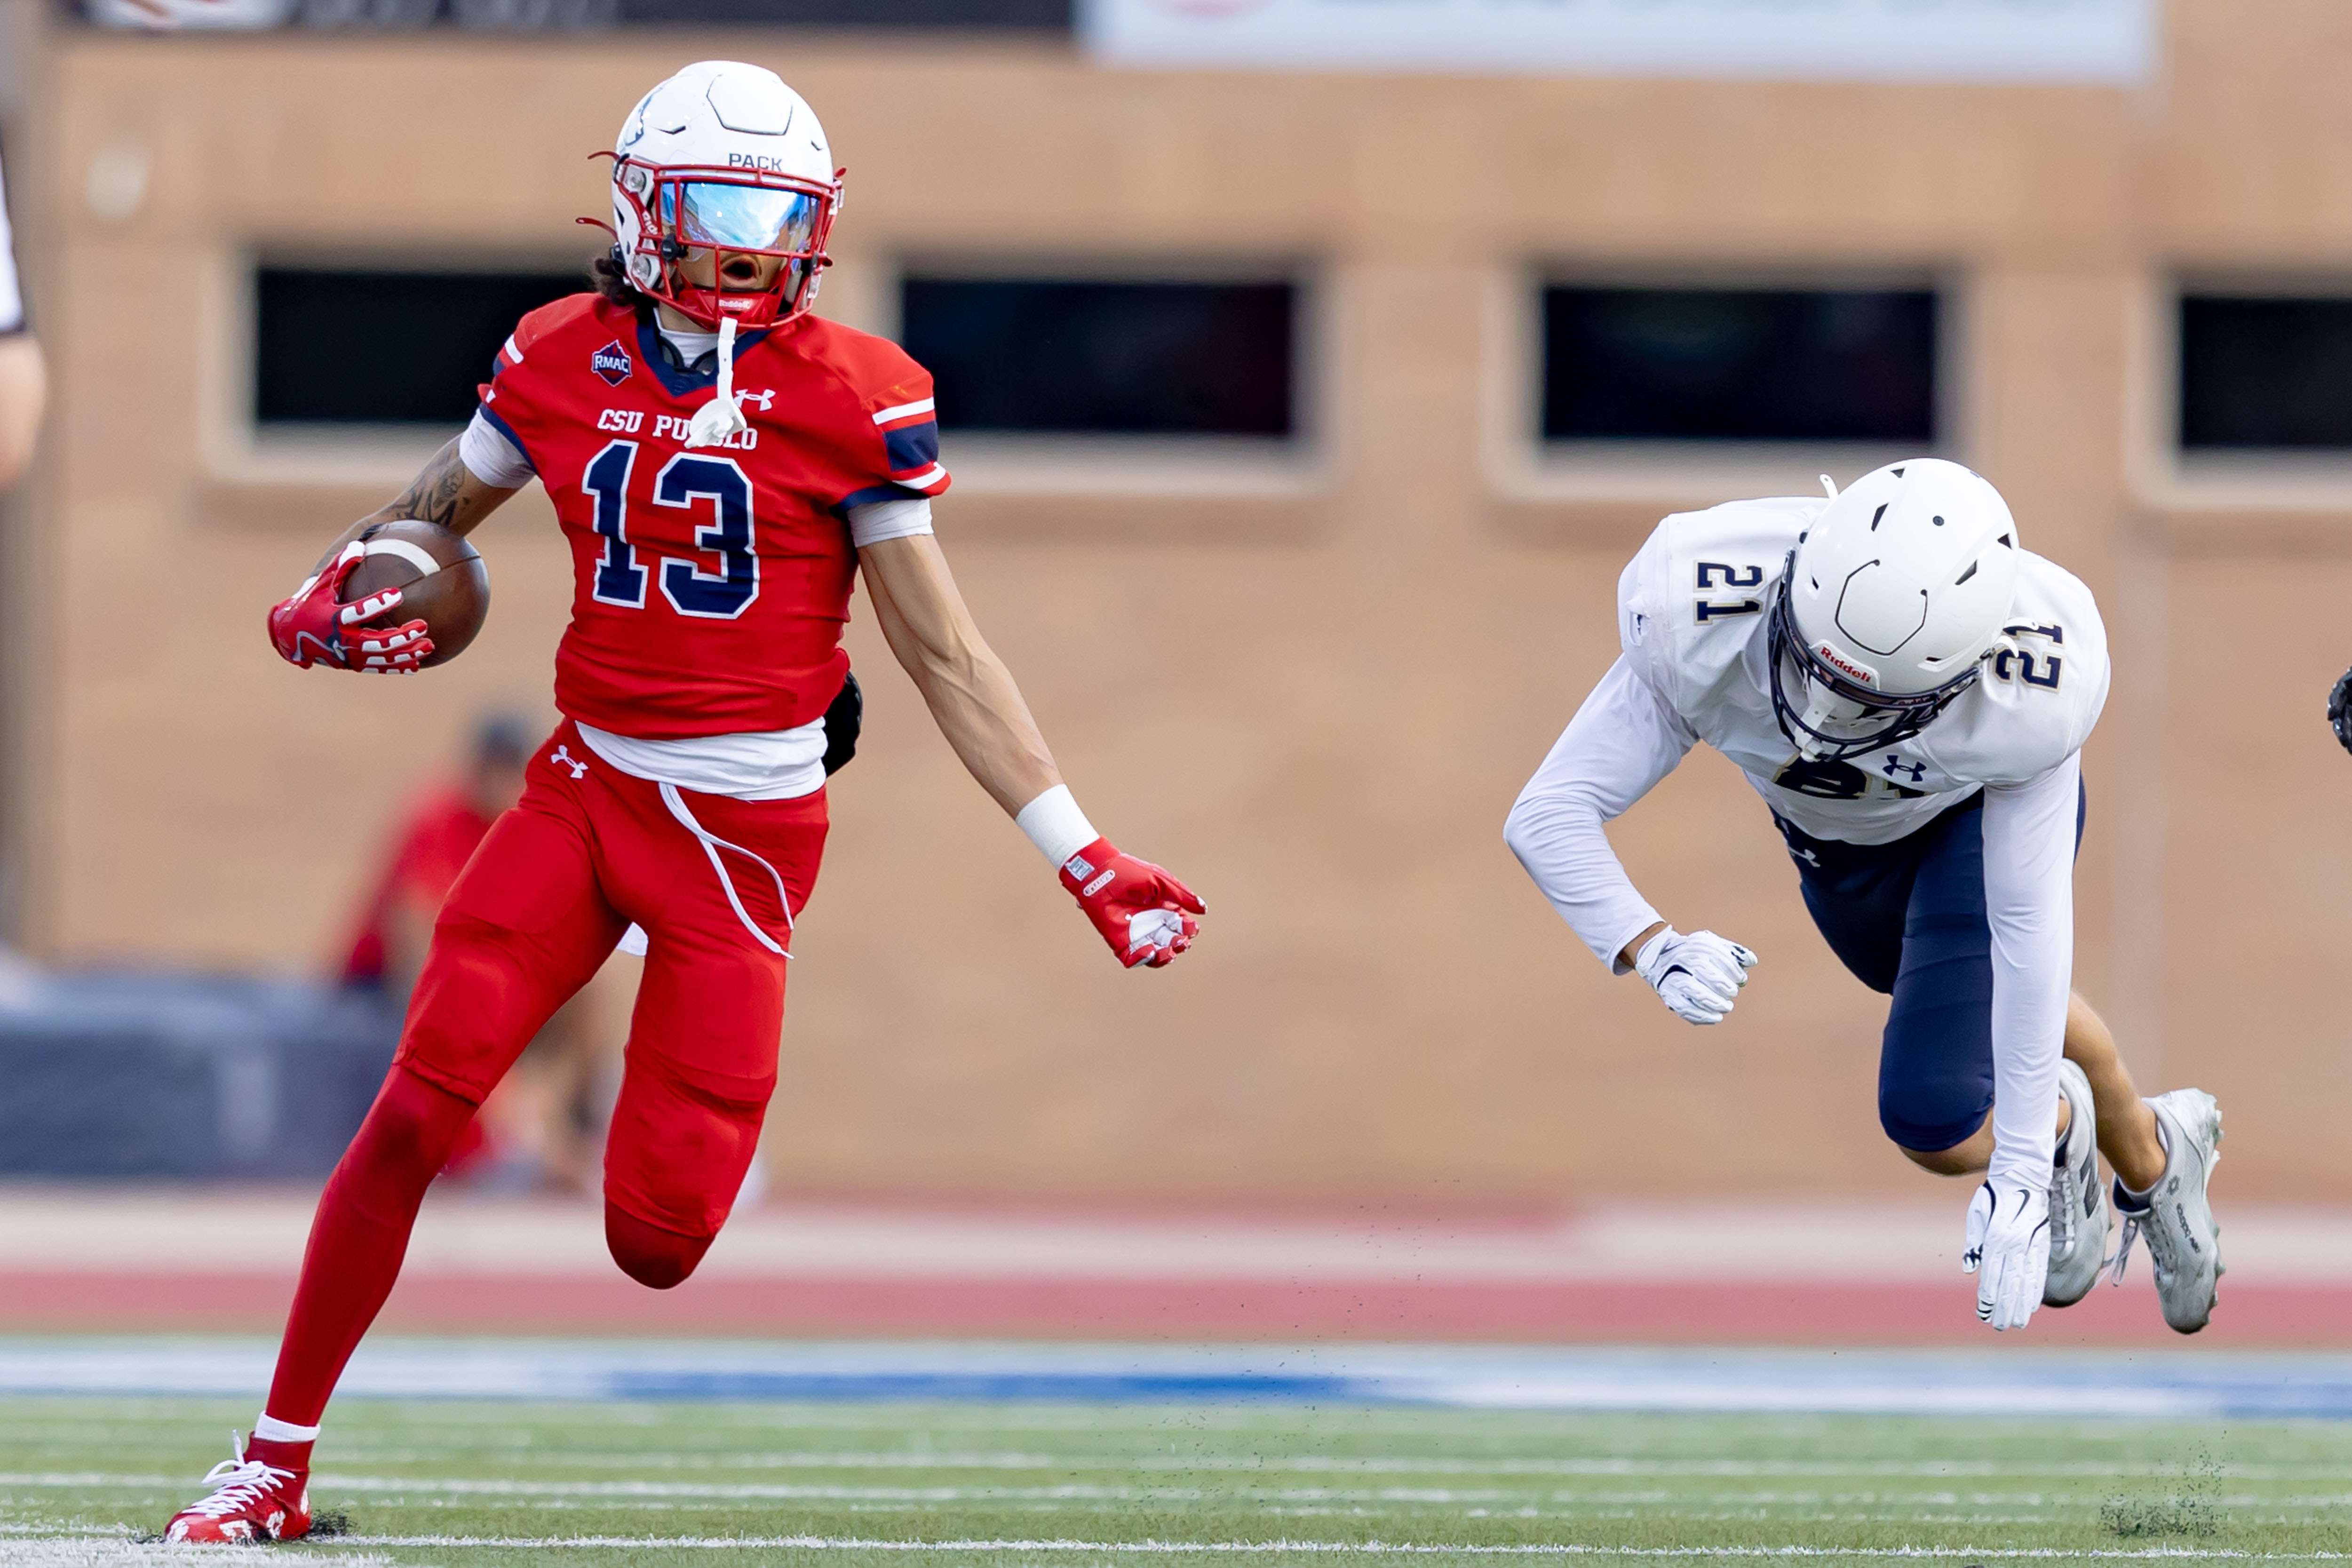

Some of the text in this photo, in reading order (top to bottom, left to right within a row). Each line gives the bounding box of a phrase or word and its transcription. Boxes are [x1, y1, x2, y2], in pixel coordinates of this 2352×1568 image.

[729, 153, 782, 172] PACK
[595, 355, 629, 373] RMAC
[597, 408, 758, 450] CSU PULO
[581, 438, 760, 620] 13
[1693, 559, 1767, 626] 21
[1992, 621, 2065, 694] 21
